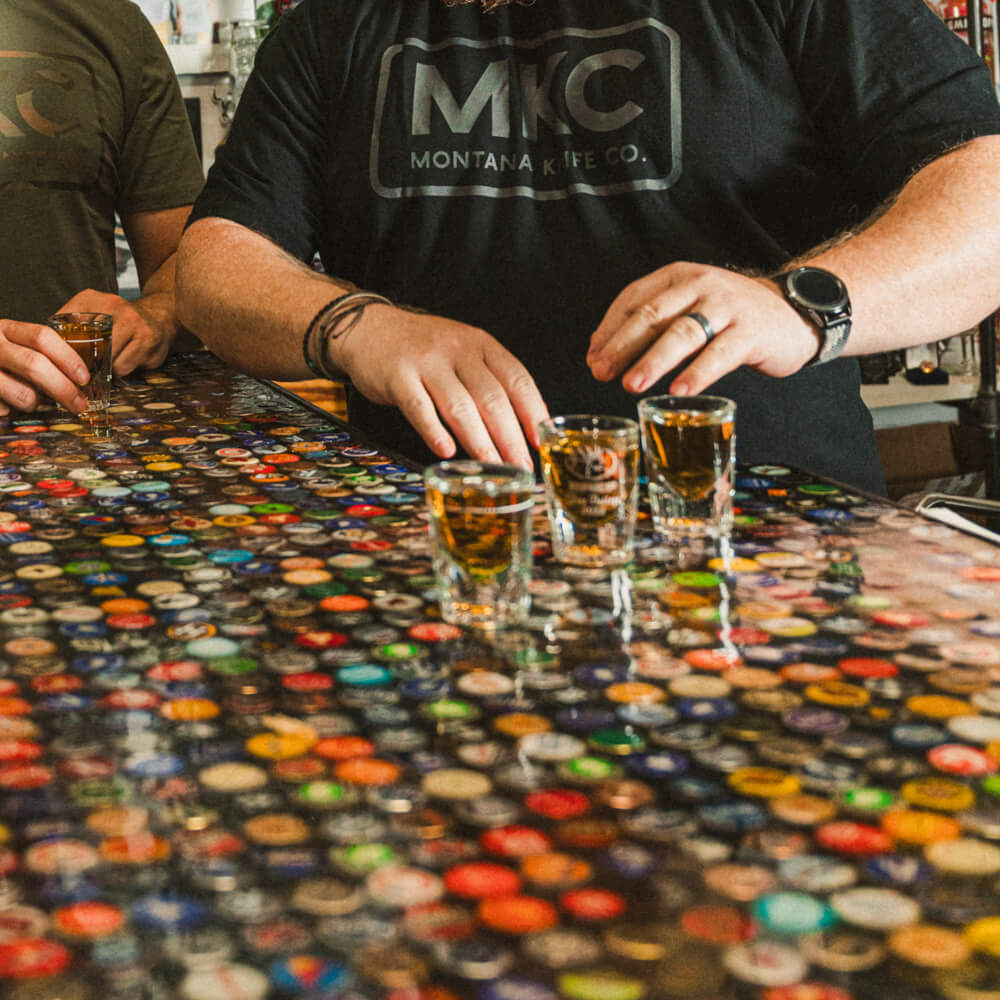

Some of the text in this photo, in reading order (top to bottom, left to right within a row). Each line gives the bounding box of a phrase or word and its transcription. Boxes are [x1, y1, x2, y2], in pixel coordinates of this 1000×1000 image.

[411, 48, 646, 140] MKC
[410, 150, 534, 172] MONTANA
[606, 144, 648, 164] CO.
